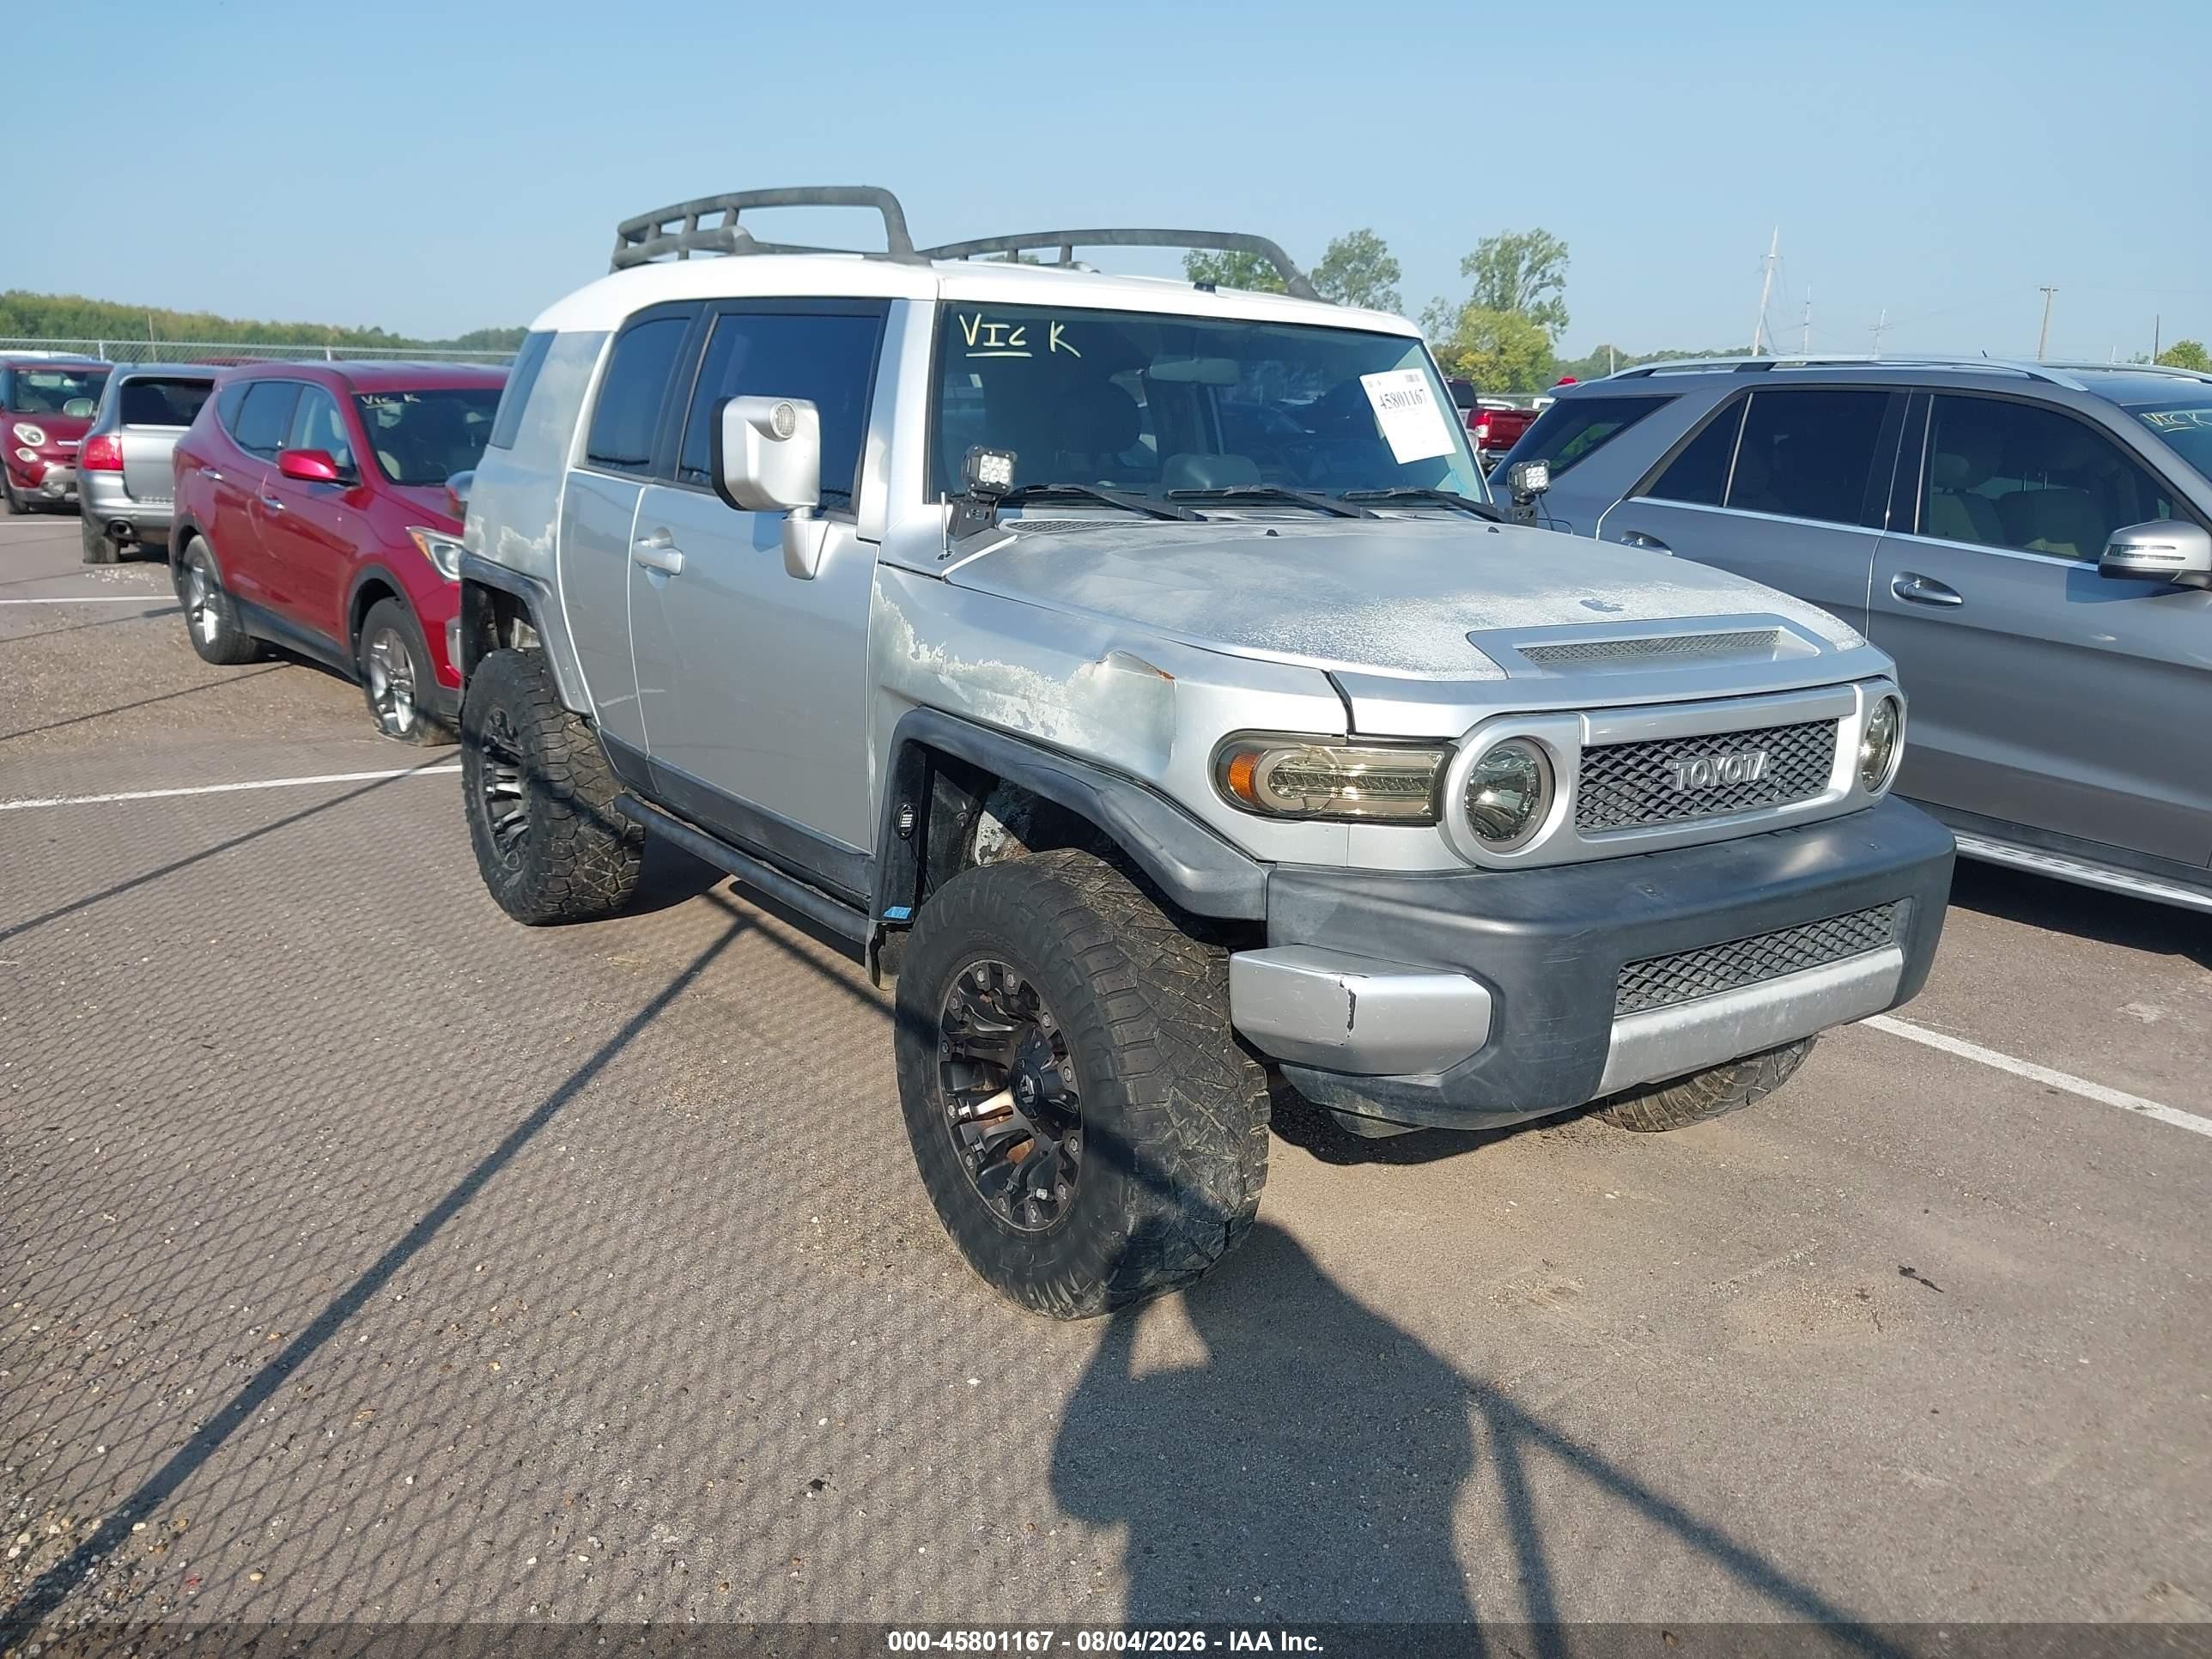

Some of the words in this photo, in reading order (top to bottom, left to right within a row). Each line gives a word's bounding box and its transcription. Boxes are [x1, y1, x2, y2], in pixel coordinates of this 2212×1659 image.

[1049, 319, 1082, 358] K
[1379, 388, 1428, 410] 45801167
[1674, 750, 1771, 791] TOYOTA
